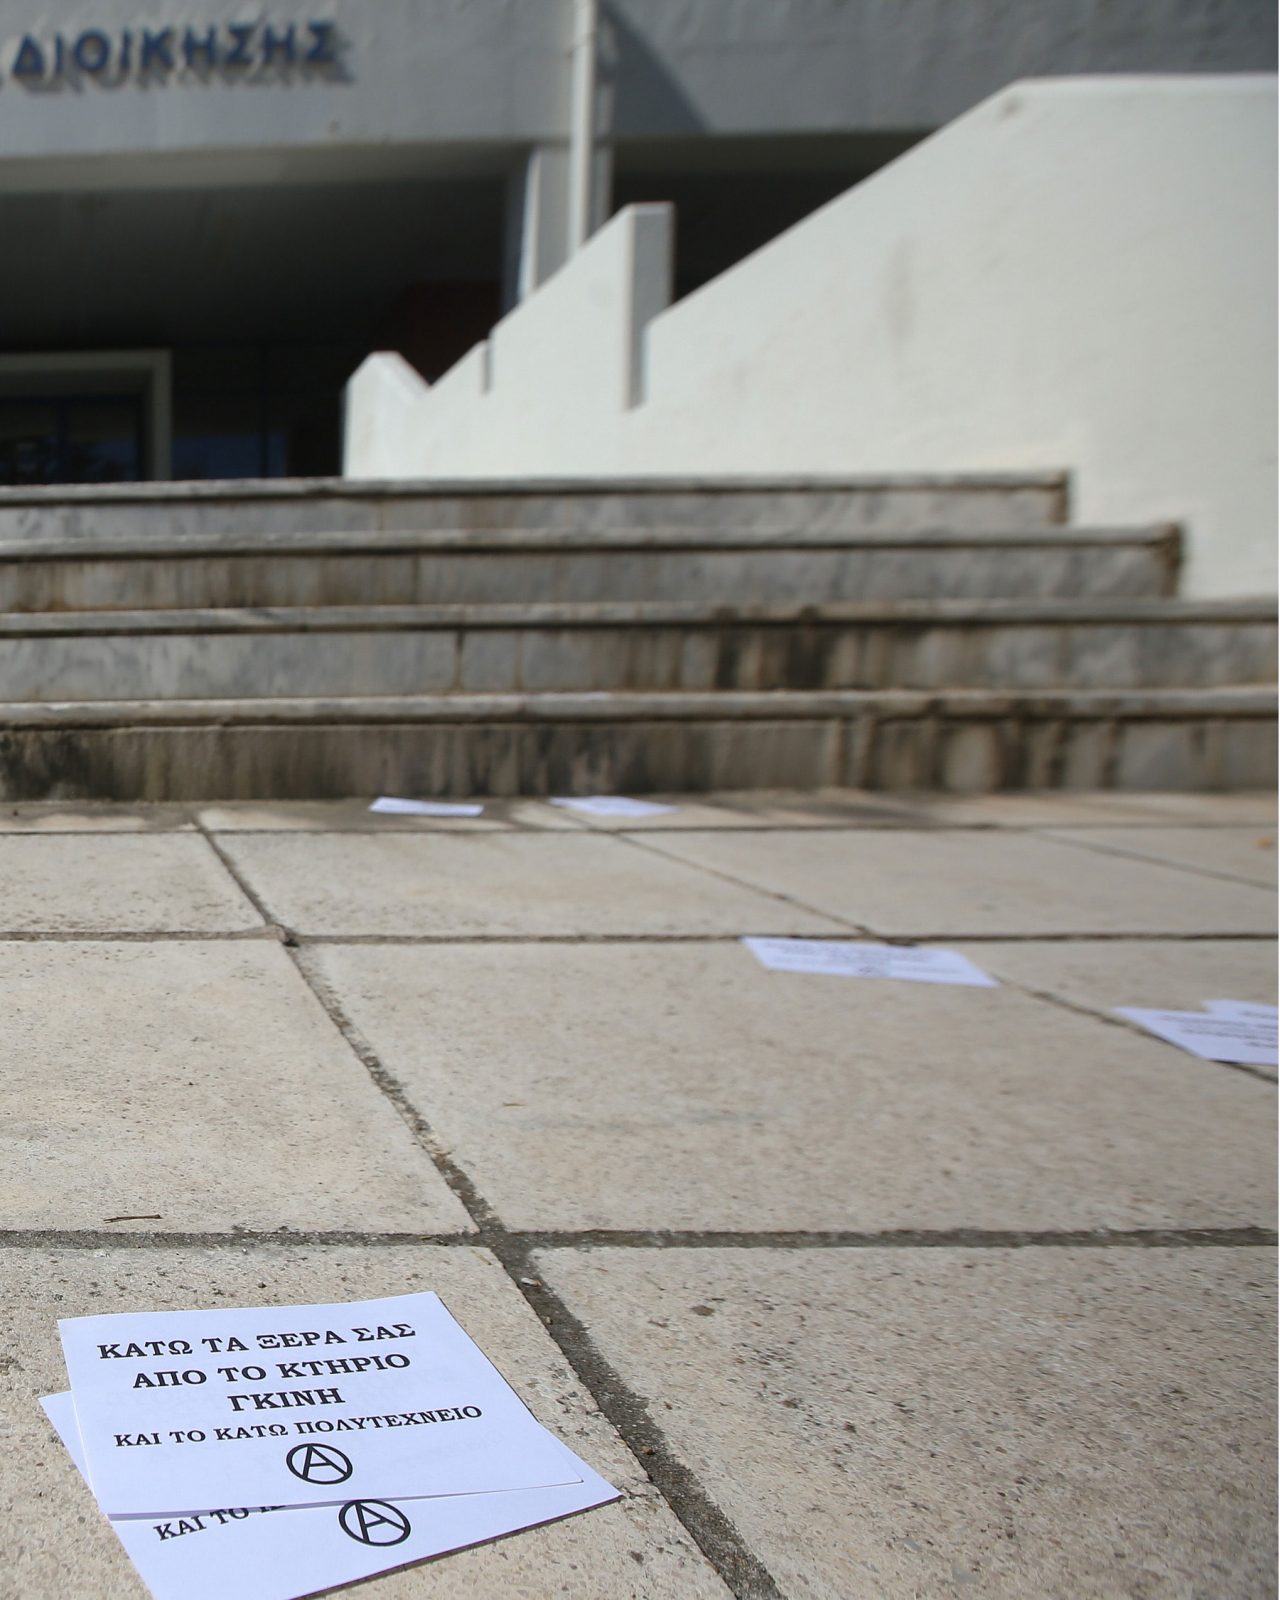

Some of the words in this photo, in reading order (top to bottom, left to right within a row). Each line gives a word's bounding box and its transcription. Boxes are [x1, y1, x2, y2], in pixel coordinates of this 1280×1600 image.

[11, 22, 339, 77] ΔΙΟΙΚΗΣΗΣ
[96, 1340, 194, 1360] ΚΑΤΩ
[201, 1336, 250, 1353] ΤΑ
[256, 1330, 348, 1349] ΞΕΡΑ
[350, 1323, 417, 1342] ΣΑΣ
[132, 1369, 208, 1389] ΑΠΟ
[217, 1365, 267, 1382] ΤΟ
[275, 1353, 411, 1379] ΚΤΗΡΙΟ
[227, 1387, 347, 1412] ΓΚΙΝΗ
[113, 1432, 163, 1447] ΚΑΙ
[169, 1430, 207, 1444] ΤΟ
[213, 1424, 289, 1441] ΚΑΤΩ
[293, 1405, 483, 1435] ΠΟΛΥΤΕΧΝΕΙΟ
[153, 1515, 207, 1541] ΚΑΙ
[210, 1507, 250, 1525] ΤΟ
